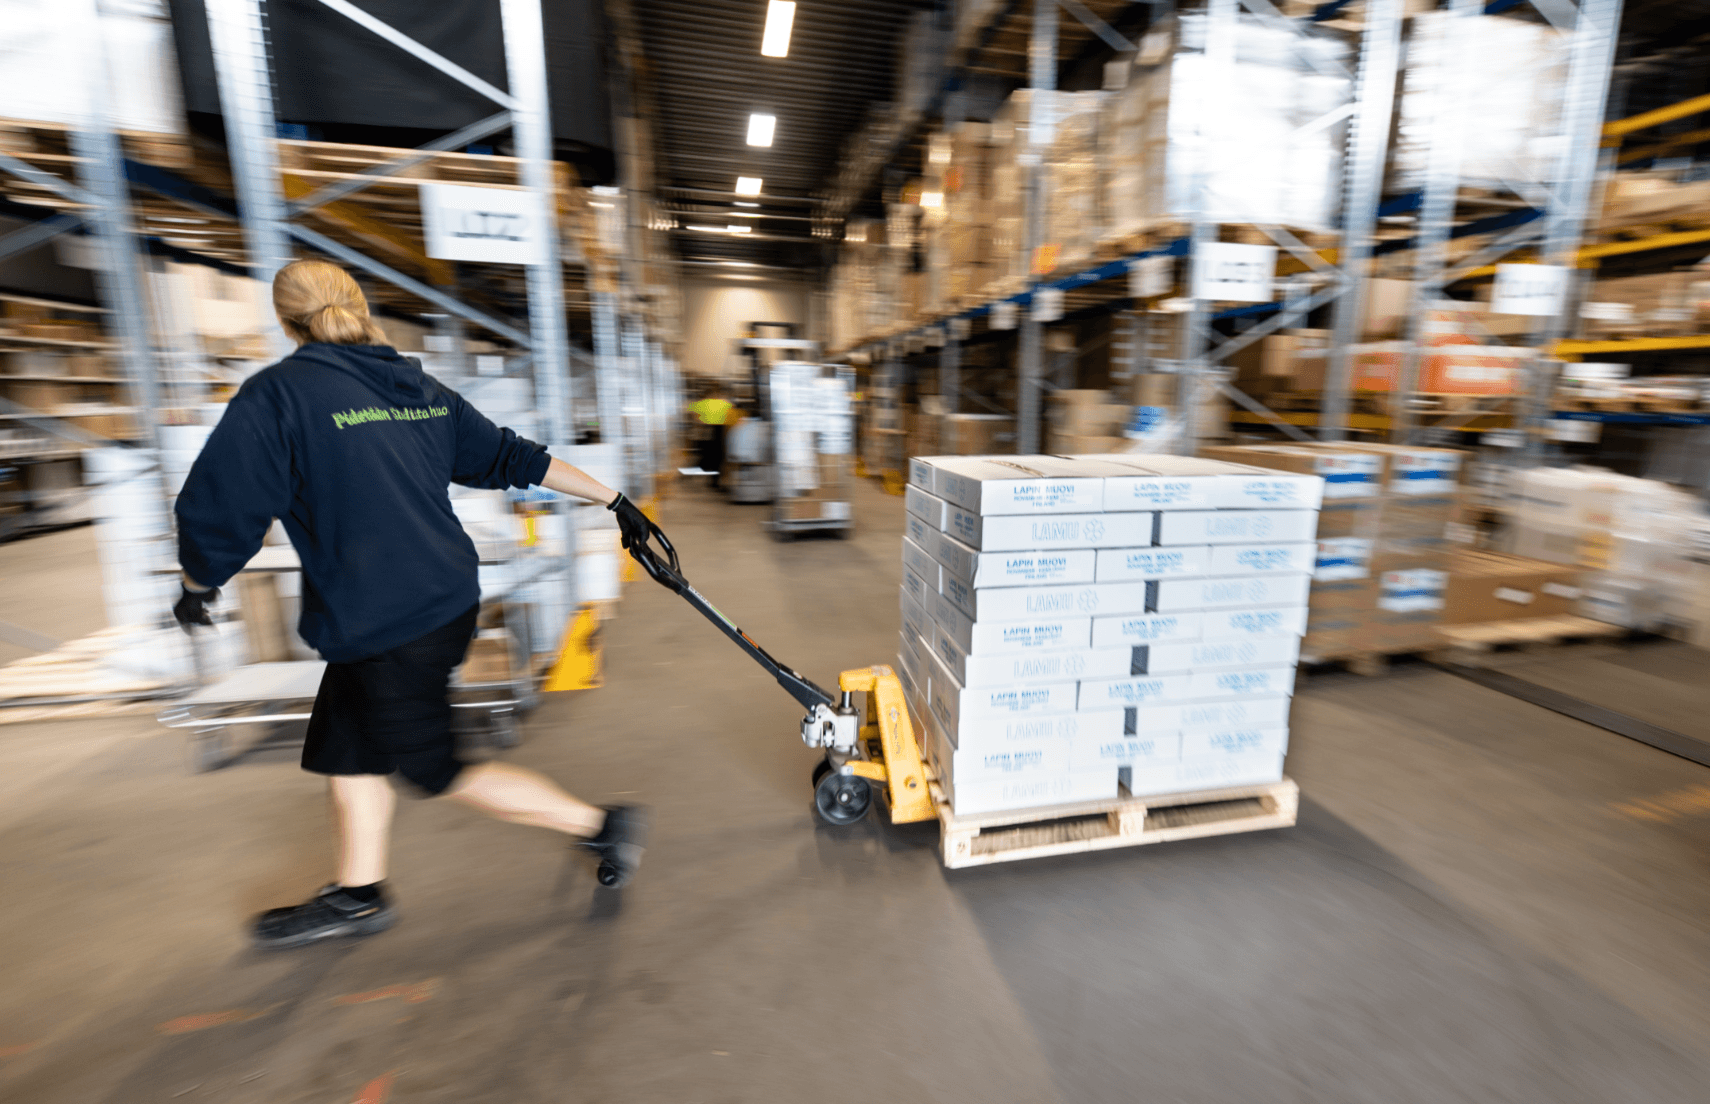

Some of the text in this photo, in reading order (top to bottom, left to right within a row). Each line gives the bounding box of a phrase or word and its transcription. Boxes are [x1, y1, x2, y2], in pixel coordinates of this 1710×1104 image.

[1013, 484, 1075, 495] LAPIN MUOVI
[1006, 557, 1067, 568] LAPIN MUOVI
[1003, 626, 1030, 636] LAPIN
